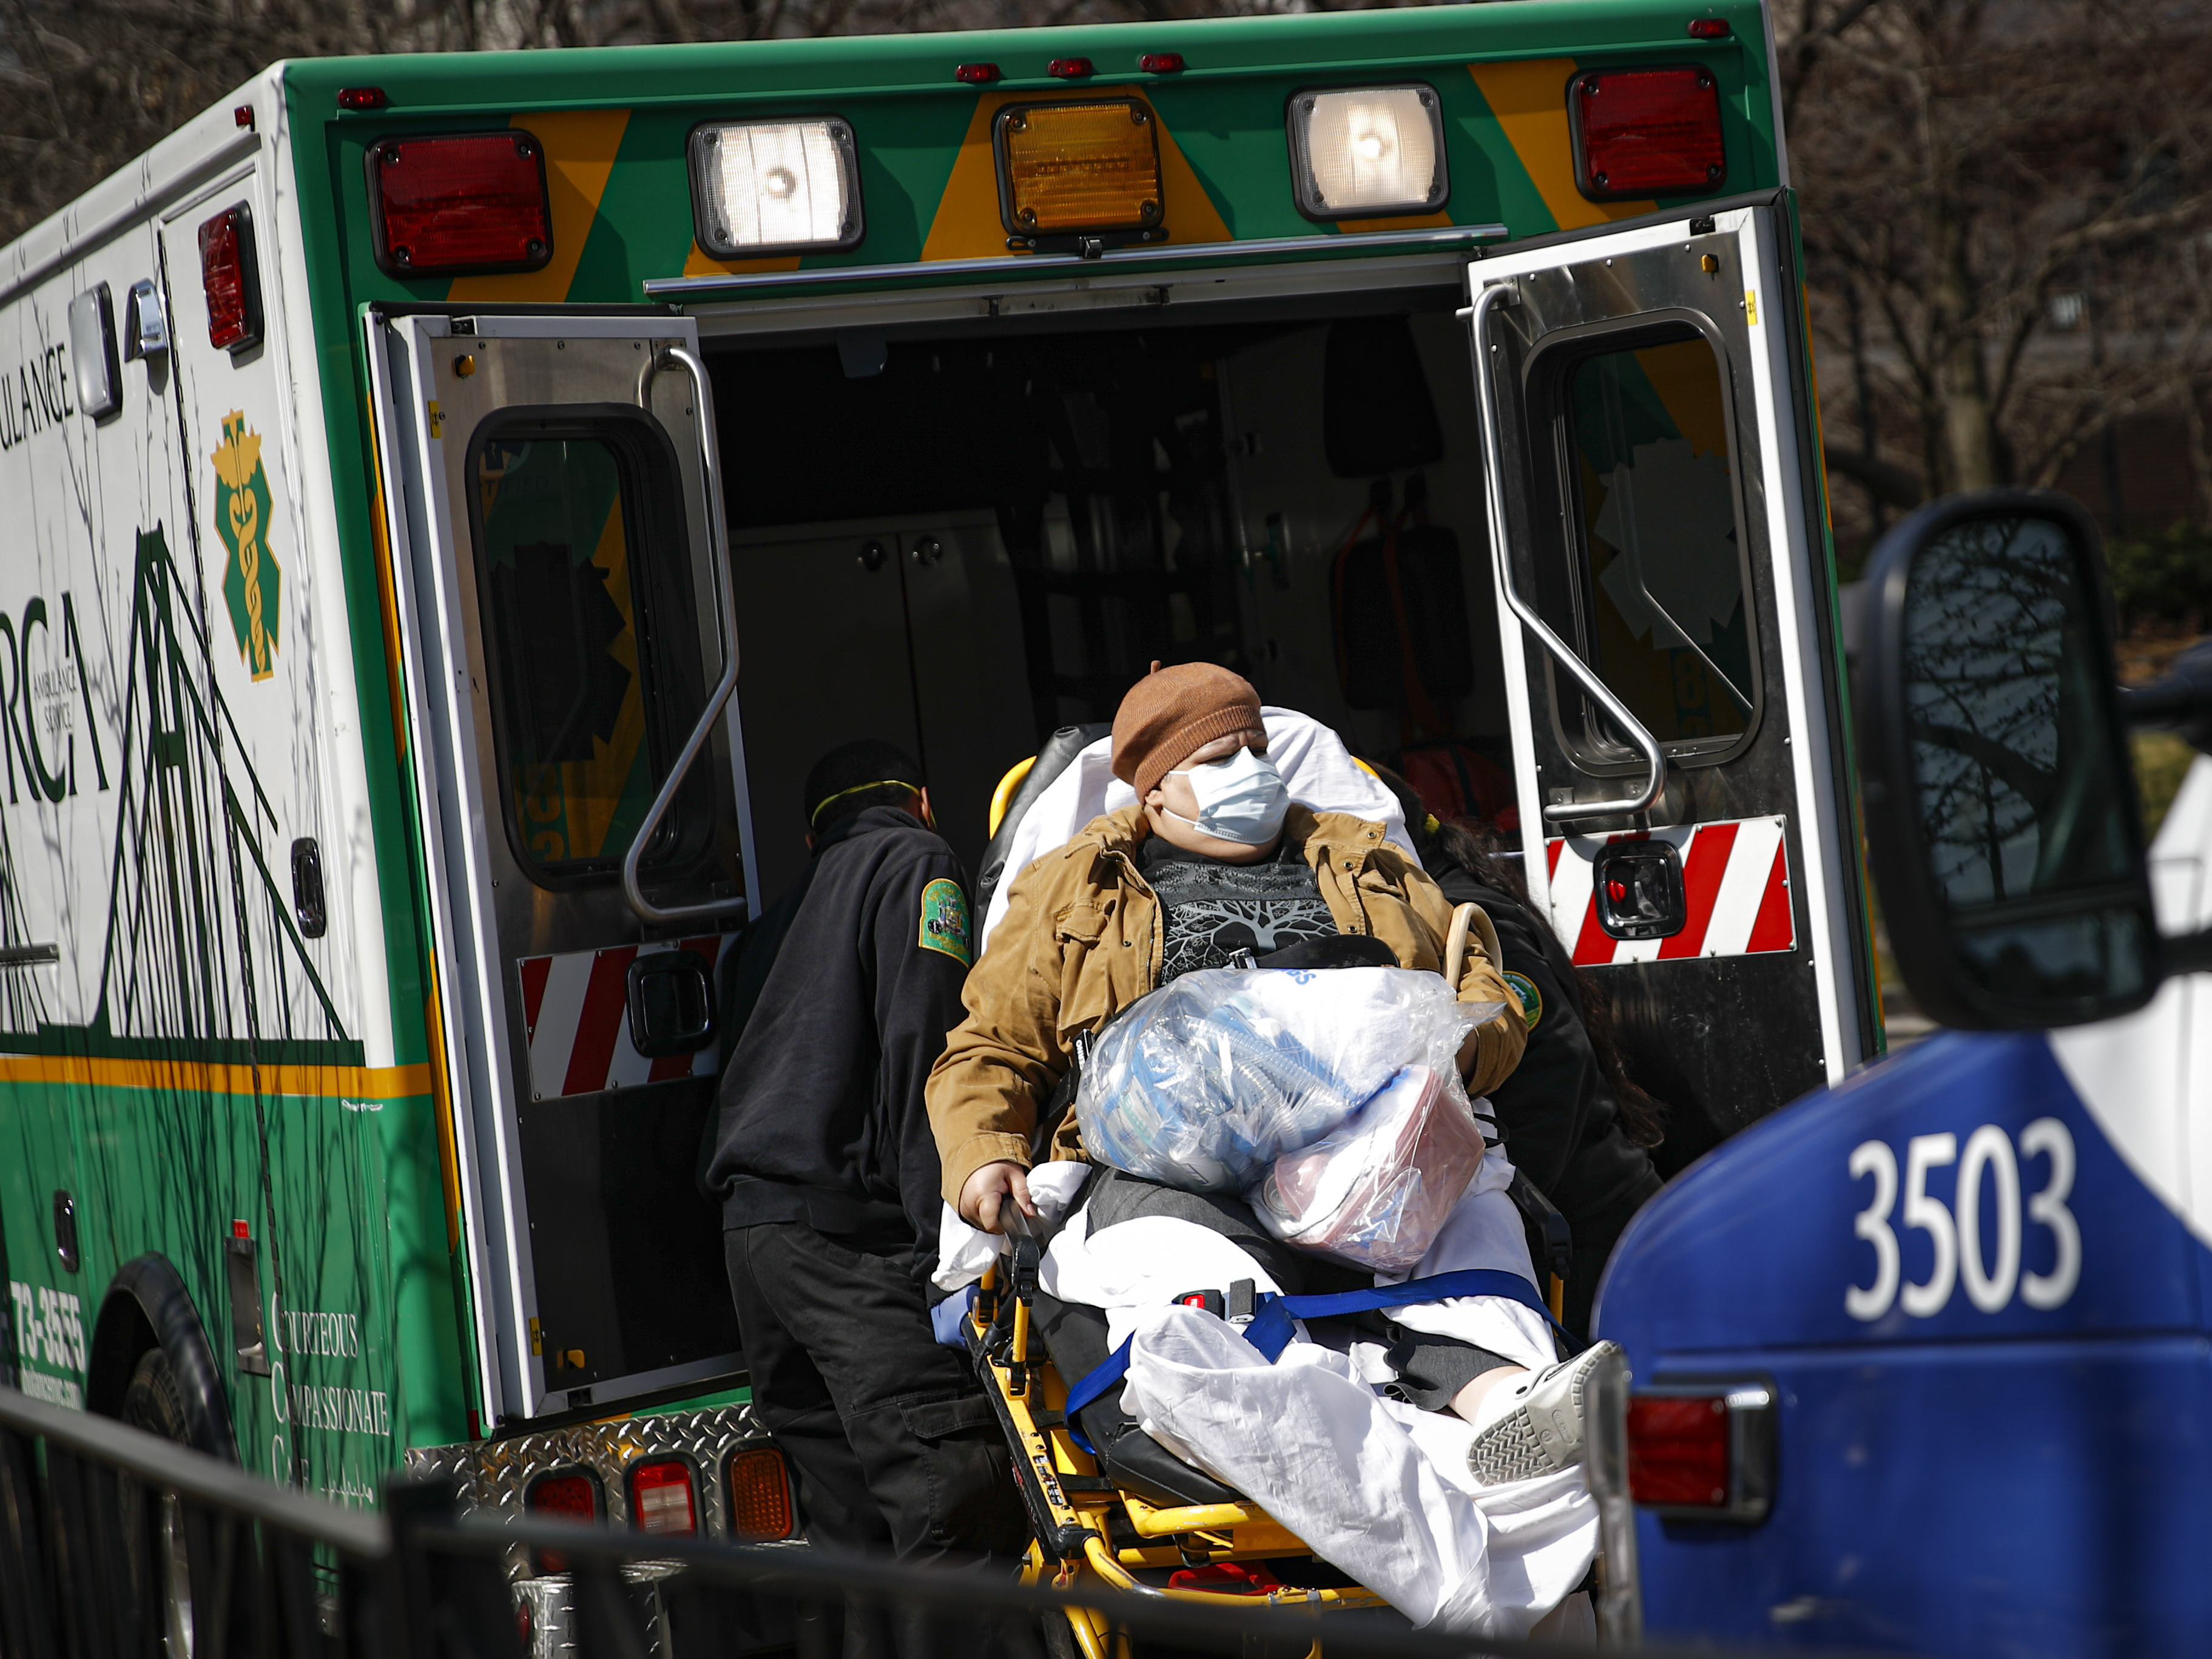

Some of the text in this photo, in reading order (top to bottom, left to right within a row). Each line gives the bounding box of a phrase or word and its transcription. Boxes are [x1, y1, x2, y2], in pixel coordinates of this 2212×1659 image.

[478, 474, 549, 496] TIFIED
[34, 665, 76, 699] AMBULANCE
[44, 701, 72, 733] SERVICE
[1843, 1115, 2083, 1322] 3503
[271, 1434, 310, 1499] CAE
